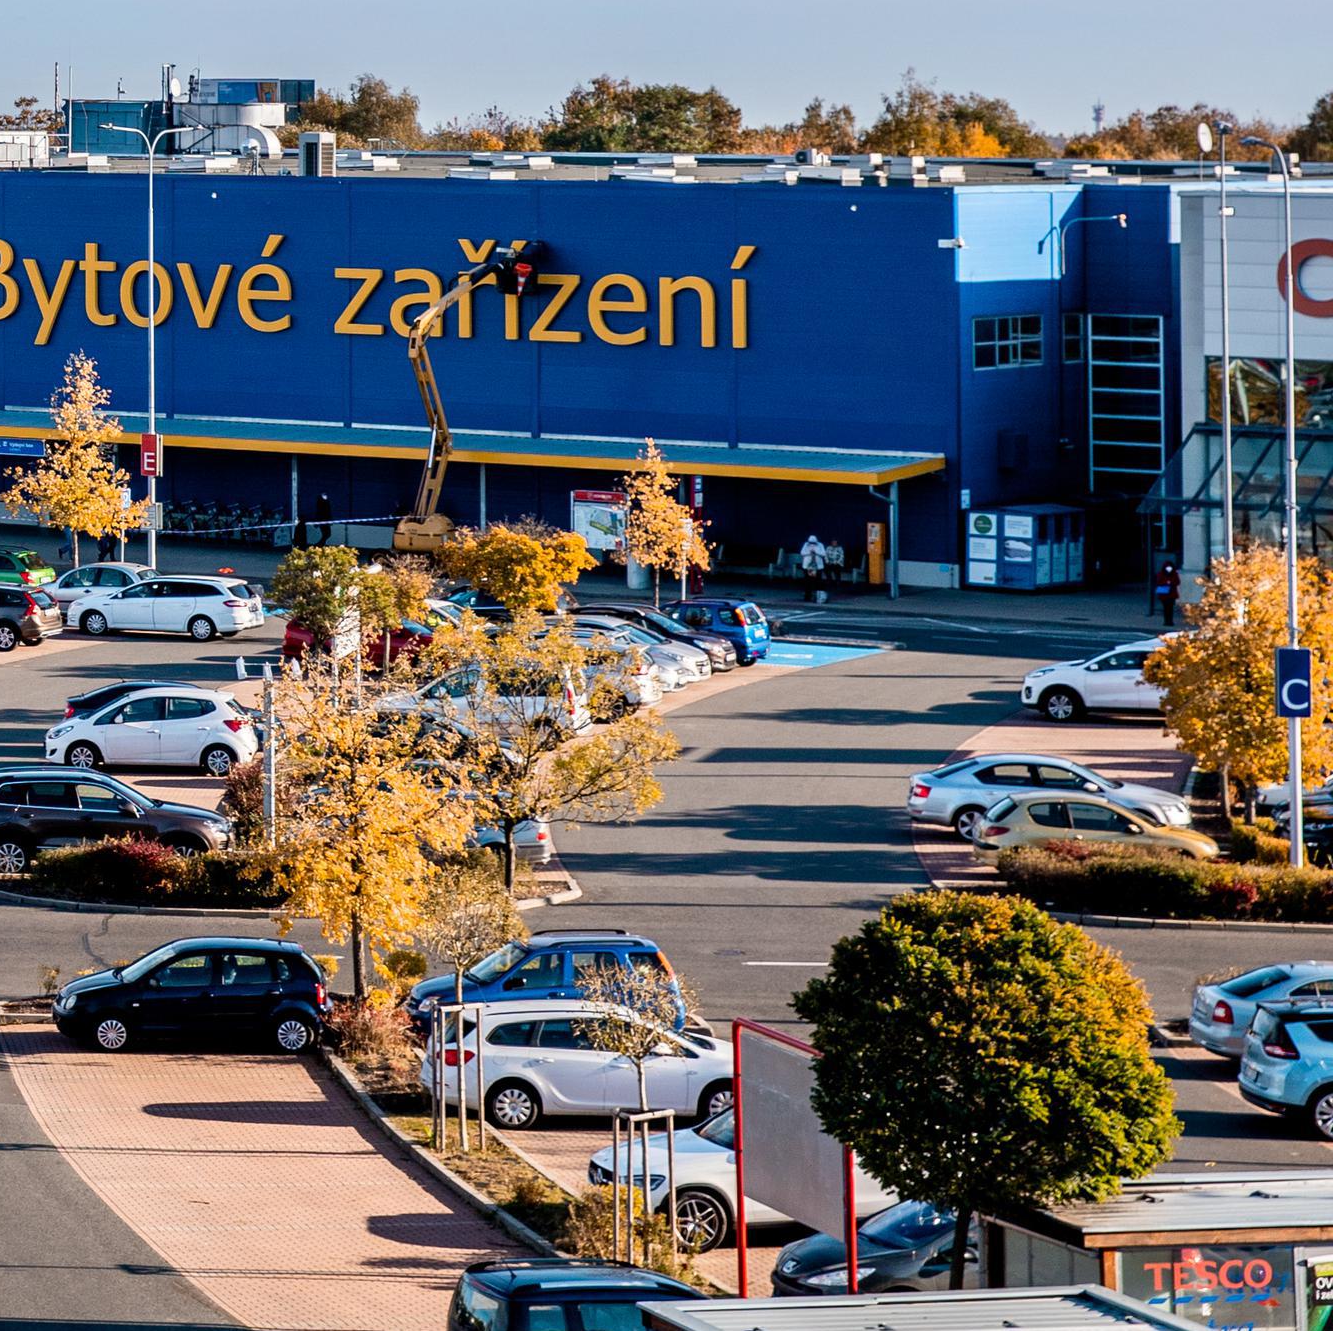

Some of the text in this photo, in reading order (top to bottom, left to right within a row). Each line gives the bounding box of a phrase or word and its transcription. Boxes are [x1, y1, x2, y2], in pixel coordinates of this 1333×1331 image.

[143, 452, 155, 471] E
[1281, 678, 1308, 710] C
[1144, 1258, 1273, 1291] TESCO
